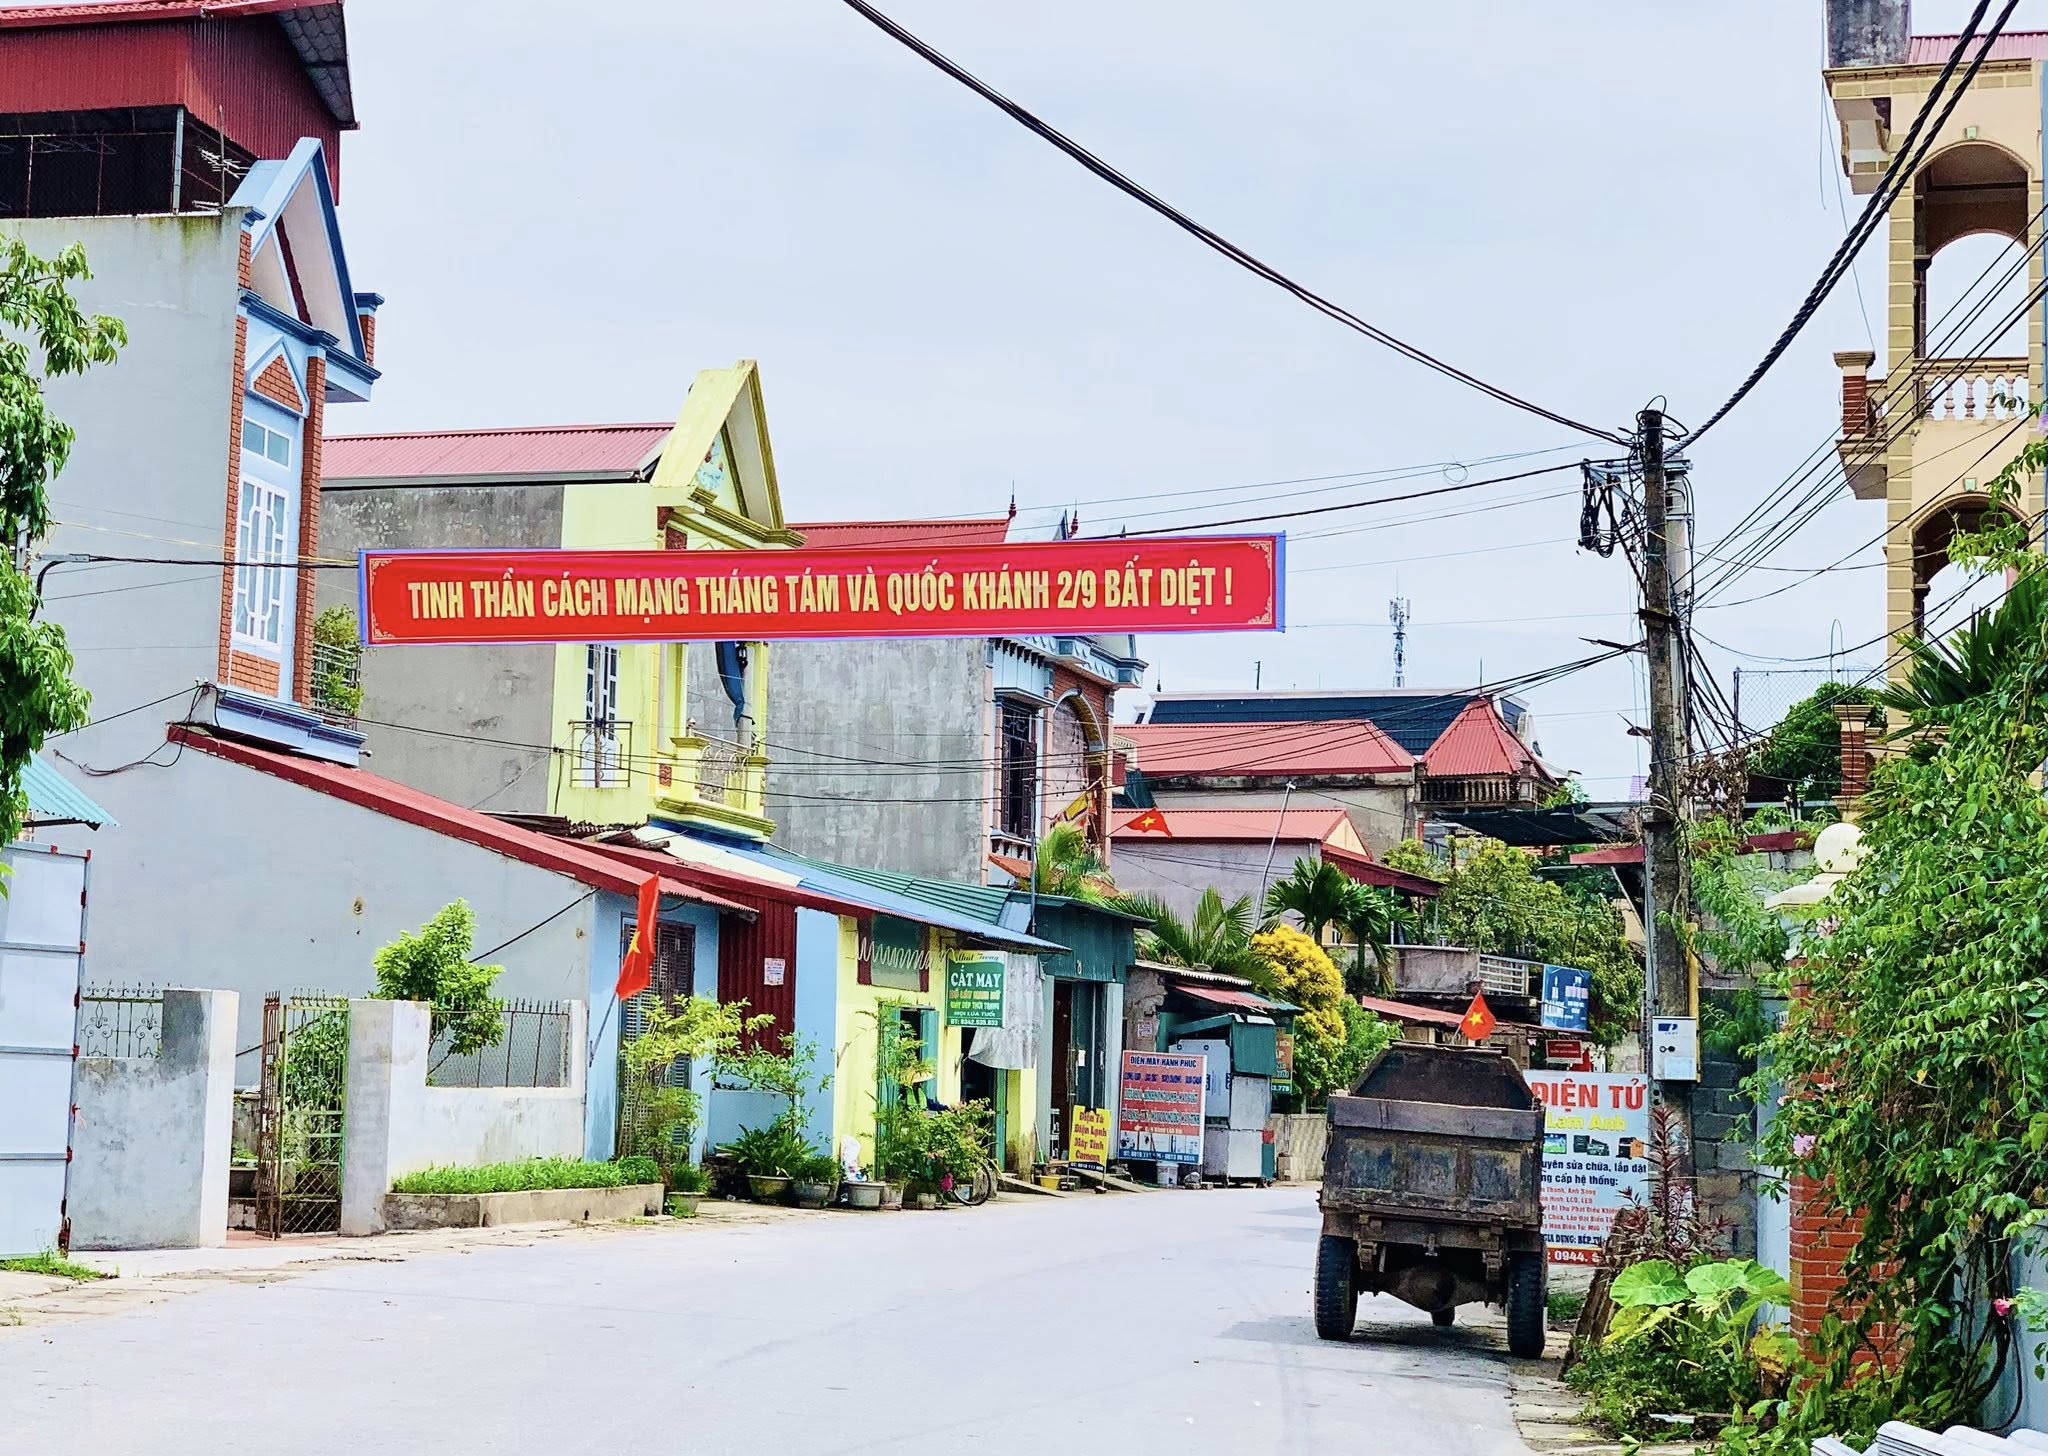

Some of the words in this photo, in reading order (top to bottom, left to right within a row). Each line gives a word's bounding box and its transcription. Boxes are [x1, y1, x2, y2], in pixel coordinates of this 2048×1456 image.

[407, 581, 465, 619] TINH
[470, 567, 535, 619] THẦN
[542, 571, 608, 617] CÁCH
[616, 576, 689, 624] MẠNG
[696, 568, 778, 615] THÁNG
[785, 568, 840, 613] TÁM
[847, 566, 880, 612] VÀ
[887, 559, 954, 616] QUỐC
[963, 563, 1049, 610] KHÁNH
[1057, 570, 1095, 608] 2/9
[1104, 554, 1151, 608] BẤT
[1160, 559, 1217, 614] DIỆT
[1224, 567, 1233, 606] !
[950, 965, 974, 987] CẮT
[976, 973, 1001, 988] MAY
[1531, 1079, 1599, 1112] ĐIỆN
[1608, 1078, 1648, 1110] TỬ
[1588, 1114, 1627, 1132] Anh
[1566, 1160, 1583, 1170] sửa
[1614, 1161, 1629, 1173] lắp
[1632, 1164, 1647, 1173] đặt
[1555, 1173, 1572, 1184] cấp
[1575, 1175, 1587, 1186] hệ
